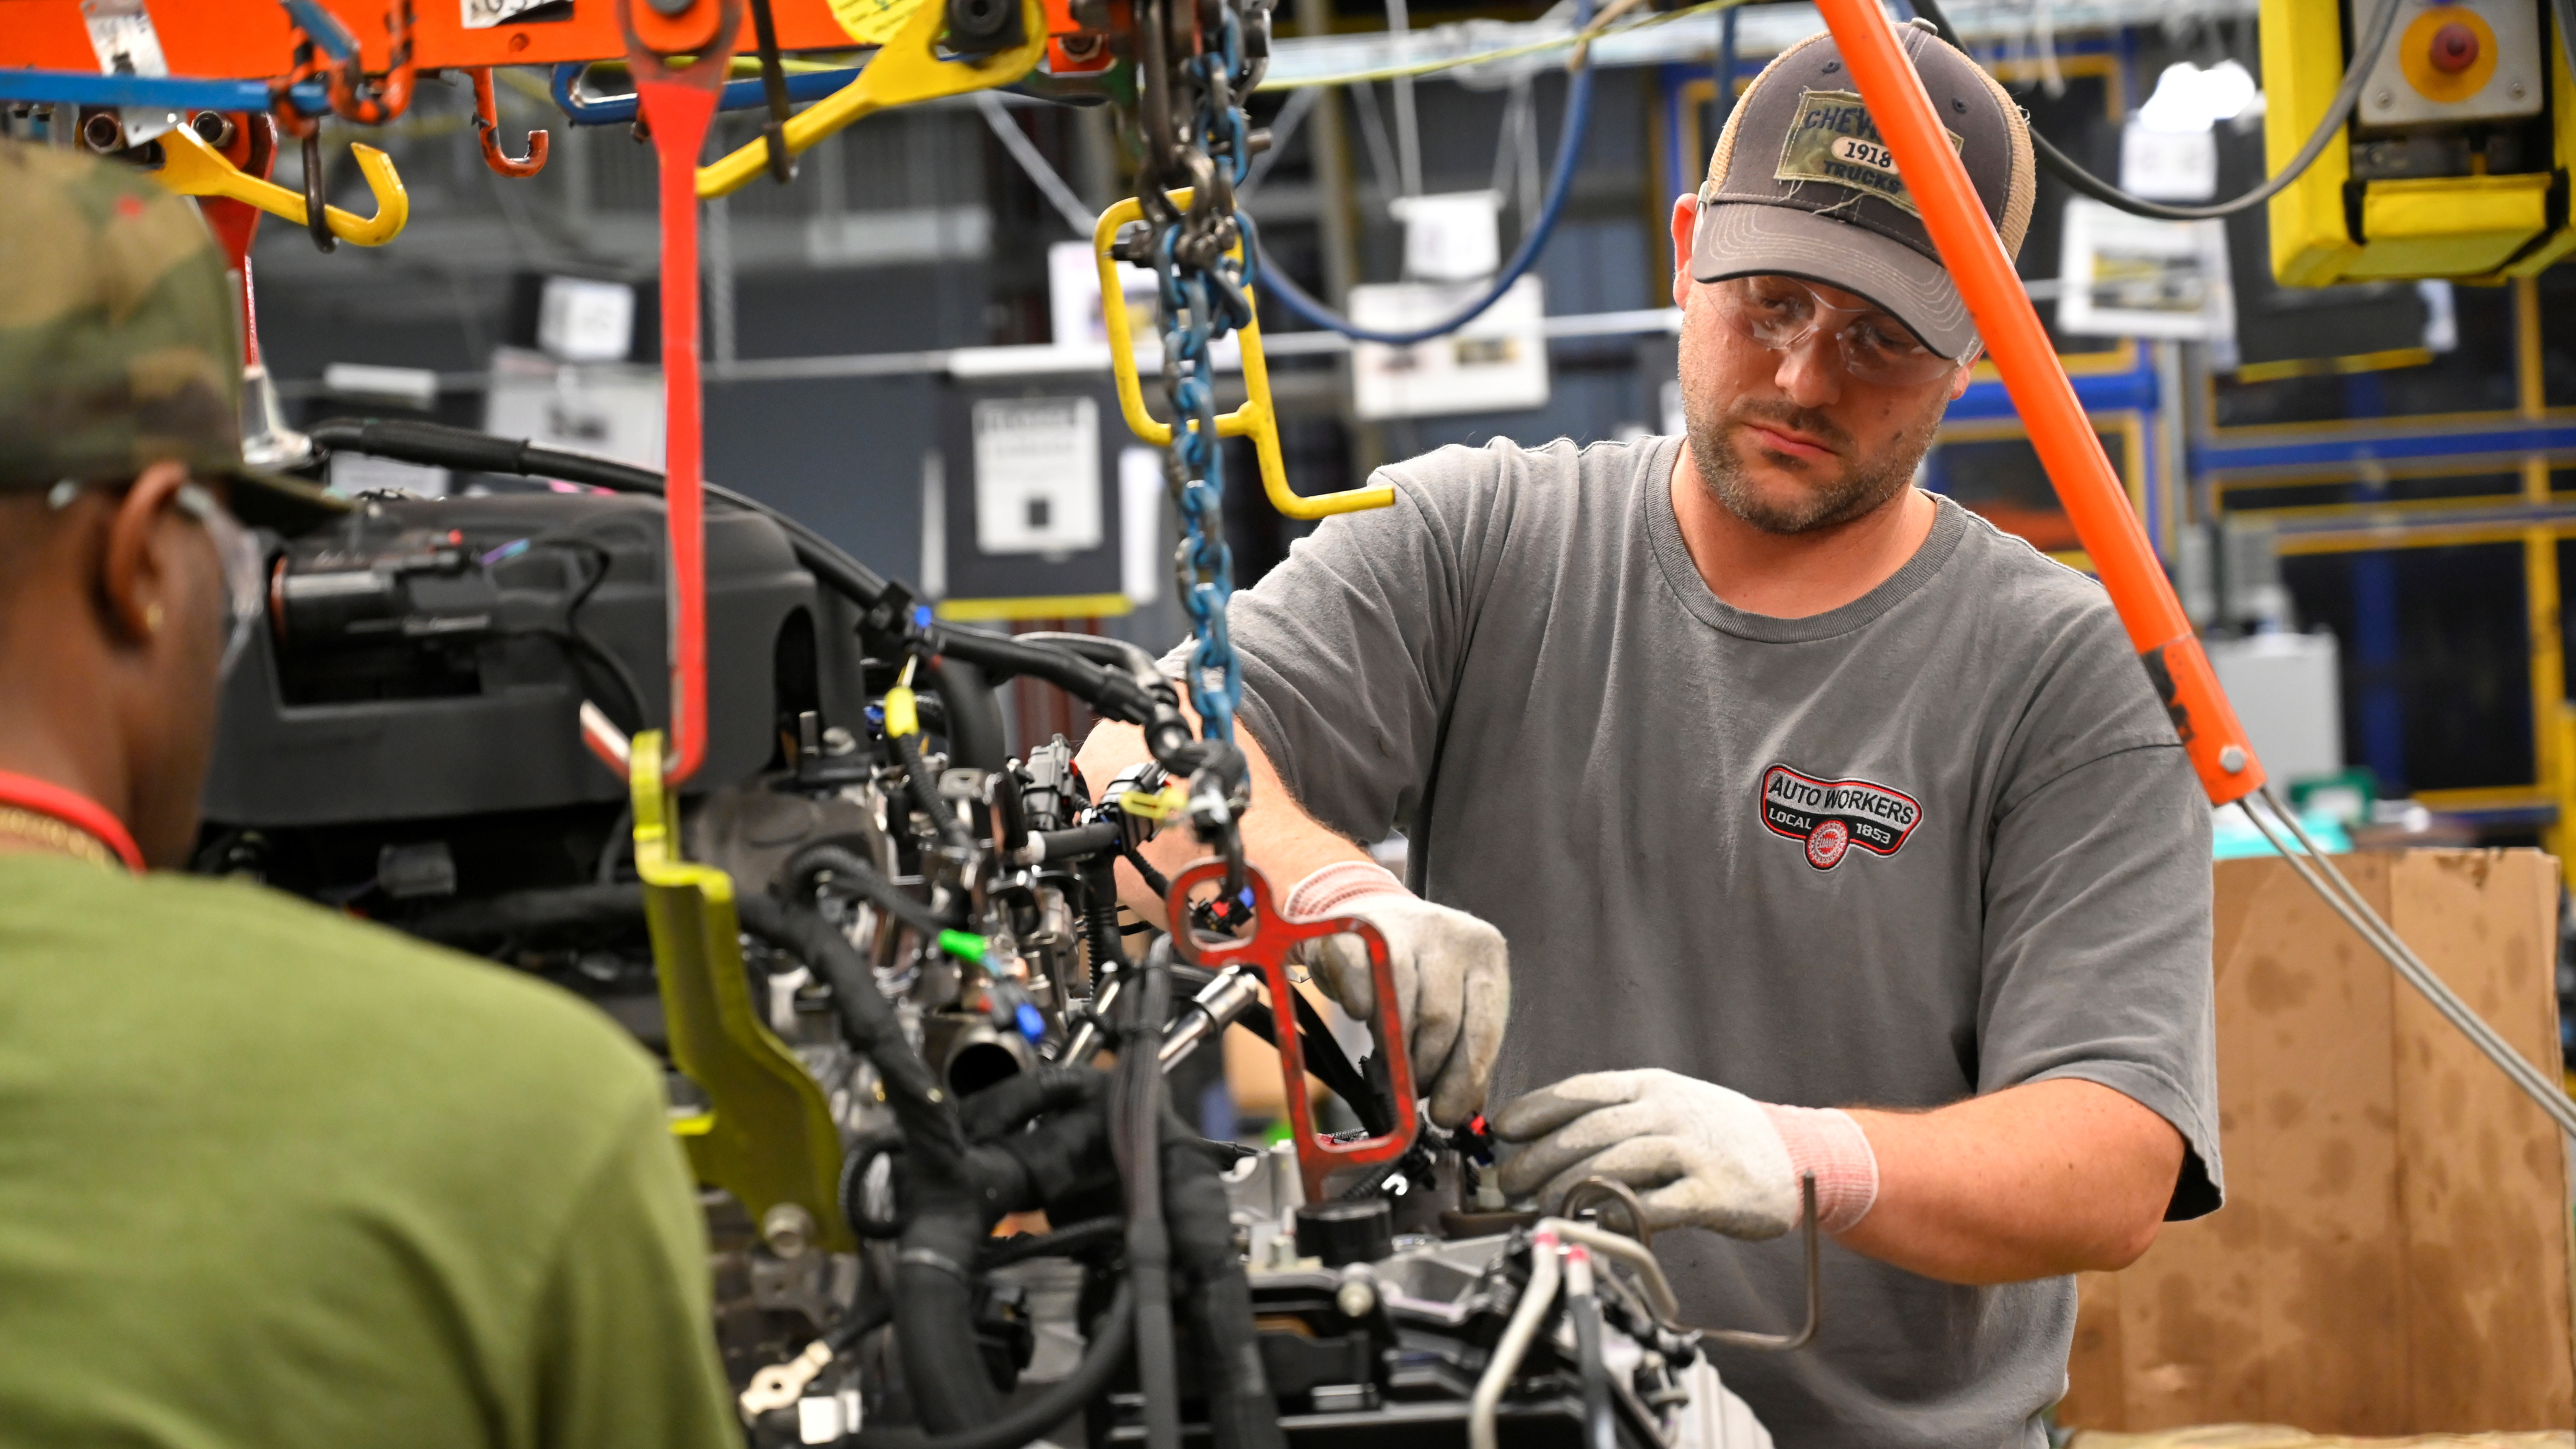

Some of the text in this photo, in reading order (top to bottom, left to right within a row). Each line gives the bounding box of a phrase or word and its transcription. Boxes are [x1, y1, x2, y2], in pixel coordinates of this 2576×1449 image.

[1844, 141, 1891, 168] 1918
[1824, 160, 1901, 194] TRUCKS
[1768, 776, 1914, 824] AUTO WORKERS
[1769, 808, 1891, 844] LOCAL 1853
